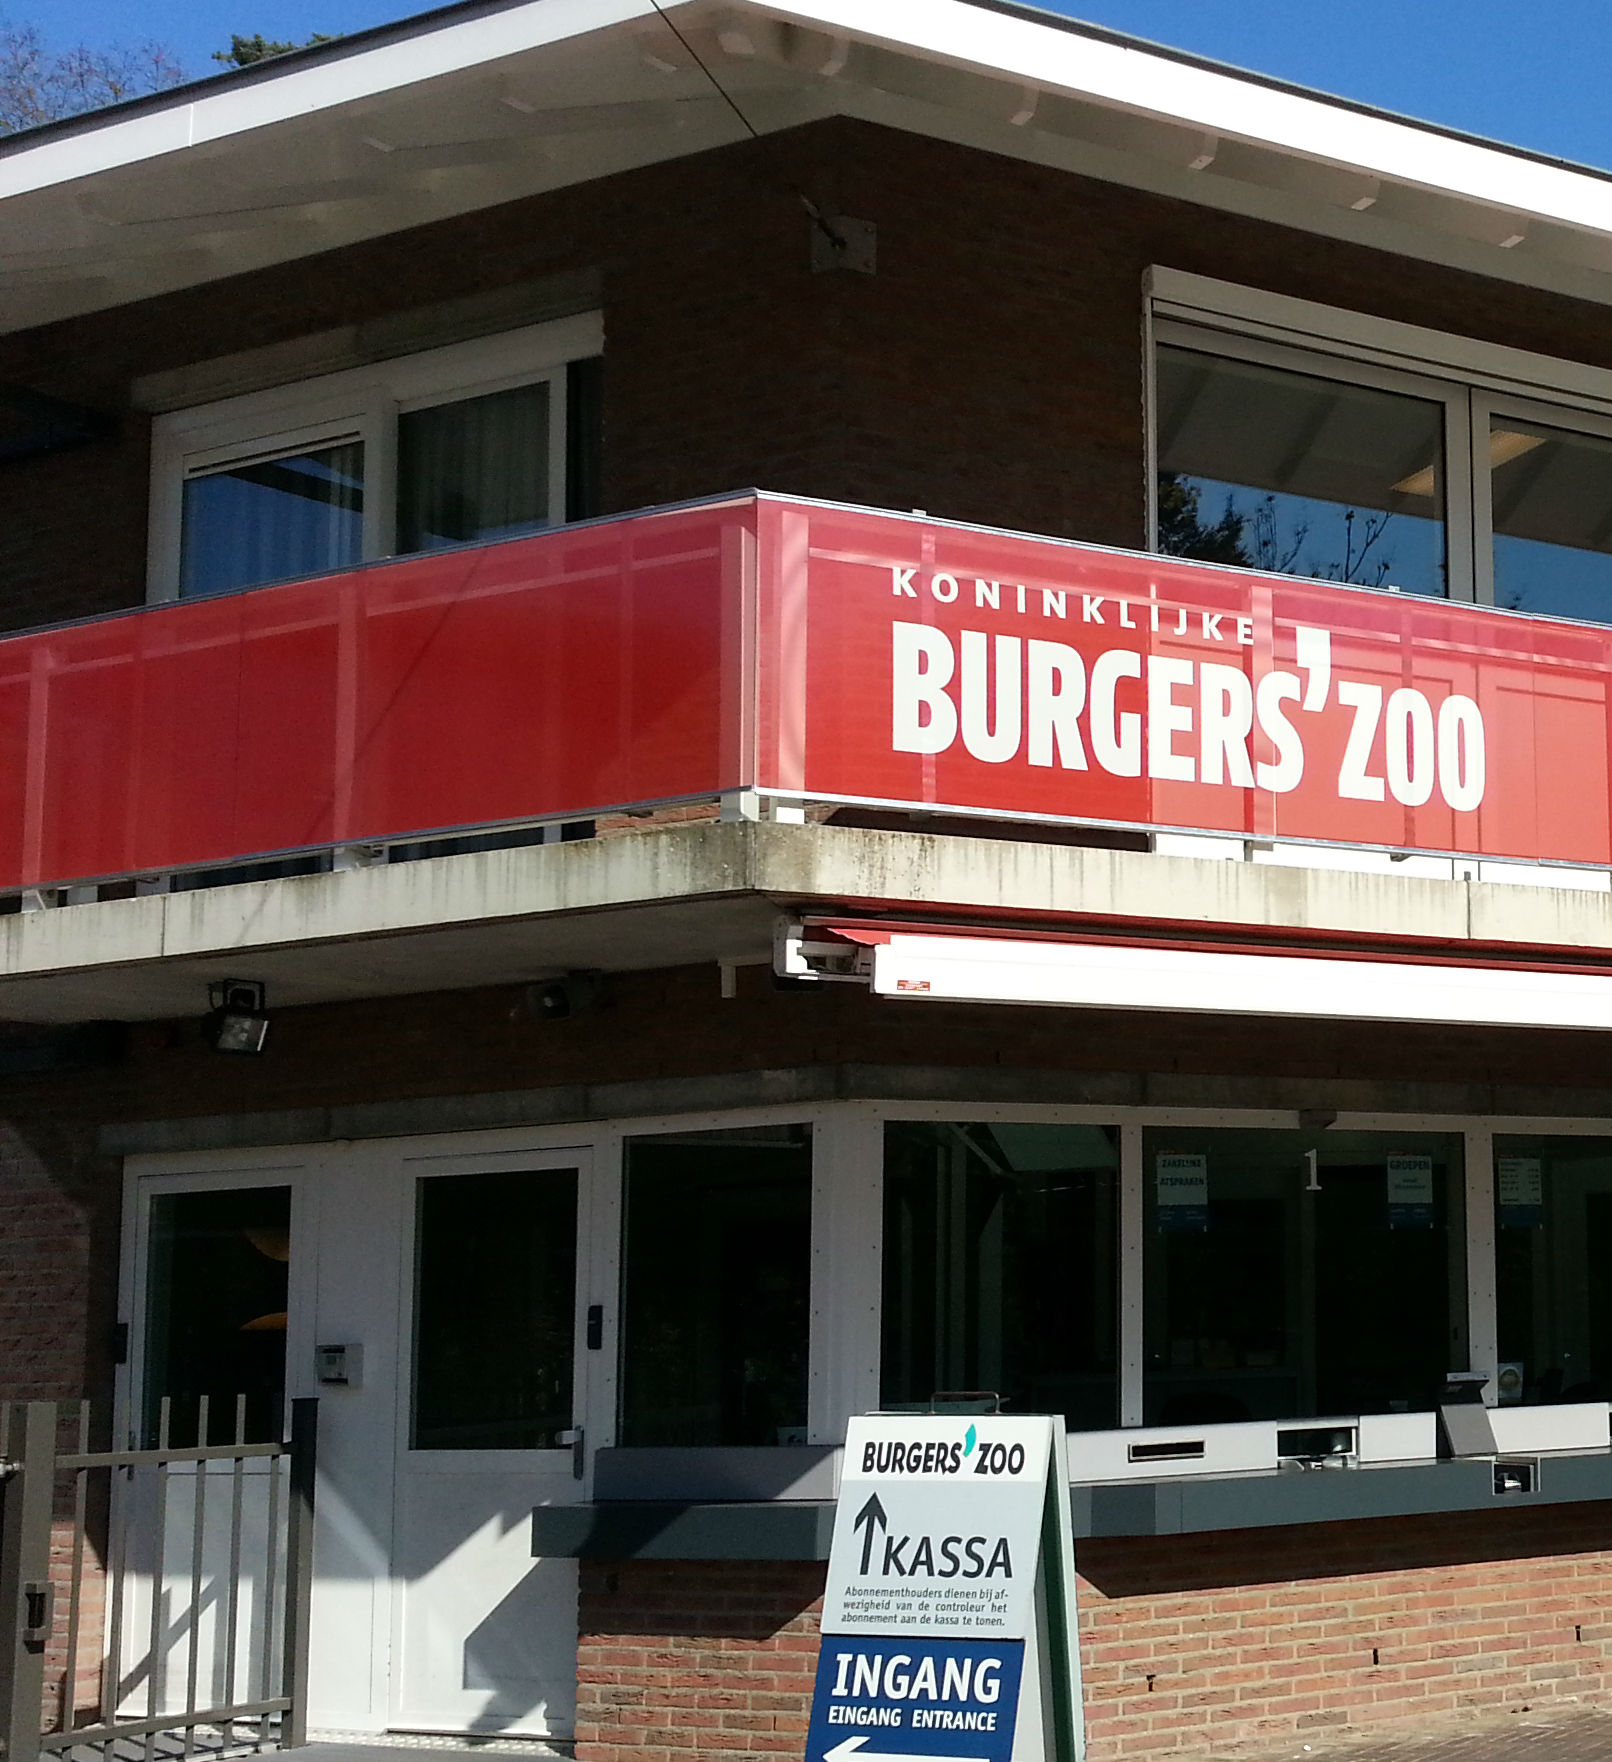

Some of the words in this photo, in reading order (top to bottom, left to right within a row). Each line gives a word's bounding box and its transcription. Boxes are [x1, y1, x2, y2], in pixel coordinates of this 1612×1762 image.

[892, 566, 1255, 646] KONINKLIJKE
[1338, 680, 1486, 812] ZOO
[1304, 1148, 1322, 1190] 1
[974, 1443, 1025, 1475] ZOO
[882, 1535, 1013, 1579] KASSA
[843, 1599, 891, 1612] wezigheid
[896, 1602, 913, 1611] van
[918, 1600, 930, 1611] de
[935, 1600, 986, 1613] controleur
[991, 1602, 1008, 1613] het
[845, 1586, 942, 1599] Abonnementhouders
[944, 1588, 977, 1600] dienen
[979, 1589, 993, 1602] bij
[841, 1613, 898, 1624] abonnement
[900, 1615, 917, 1624] aan
[920, 1613, 932, 1625] de
[934, 1614, 959, 1625] kassa
[962, 1615, 972, 1626] te
[976, 1616, 1005, 1627] tonen.
[831, 1653, 1003, 1704] INGANG
[828, 1706, 902, 1727] EINGANG
[911, 1709, 998, 1731] ENTRANCE
